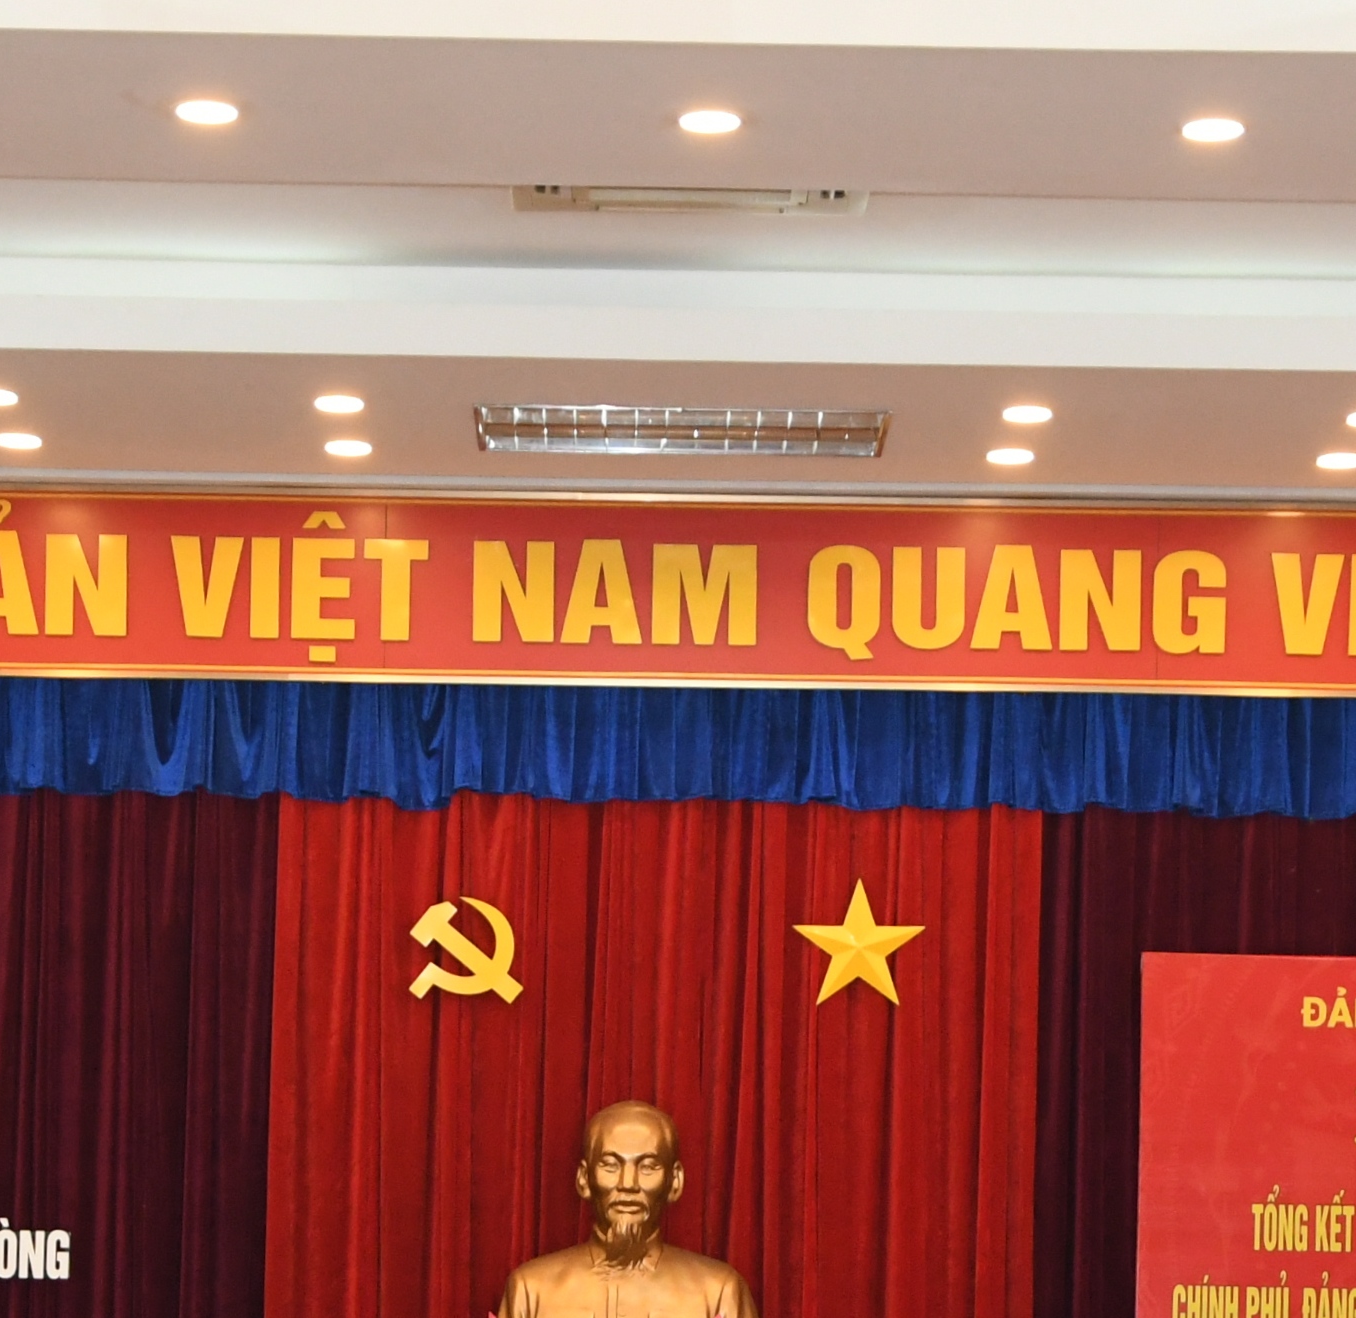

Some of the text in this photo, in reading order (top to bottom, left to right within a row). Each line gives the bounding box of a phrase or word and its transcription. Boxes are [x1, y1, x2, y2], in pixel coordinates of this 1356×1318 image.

[170, 510, 431, 662] VIỆT
[472, 539, 758, 646] NAM
[806, 543, 1227, 660] QUANG
[1253, 1186, 1307, 1250] TỔNG
[1316, 1191, 1354, 1251] KẾT
